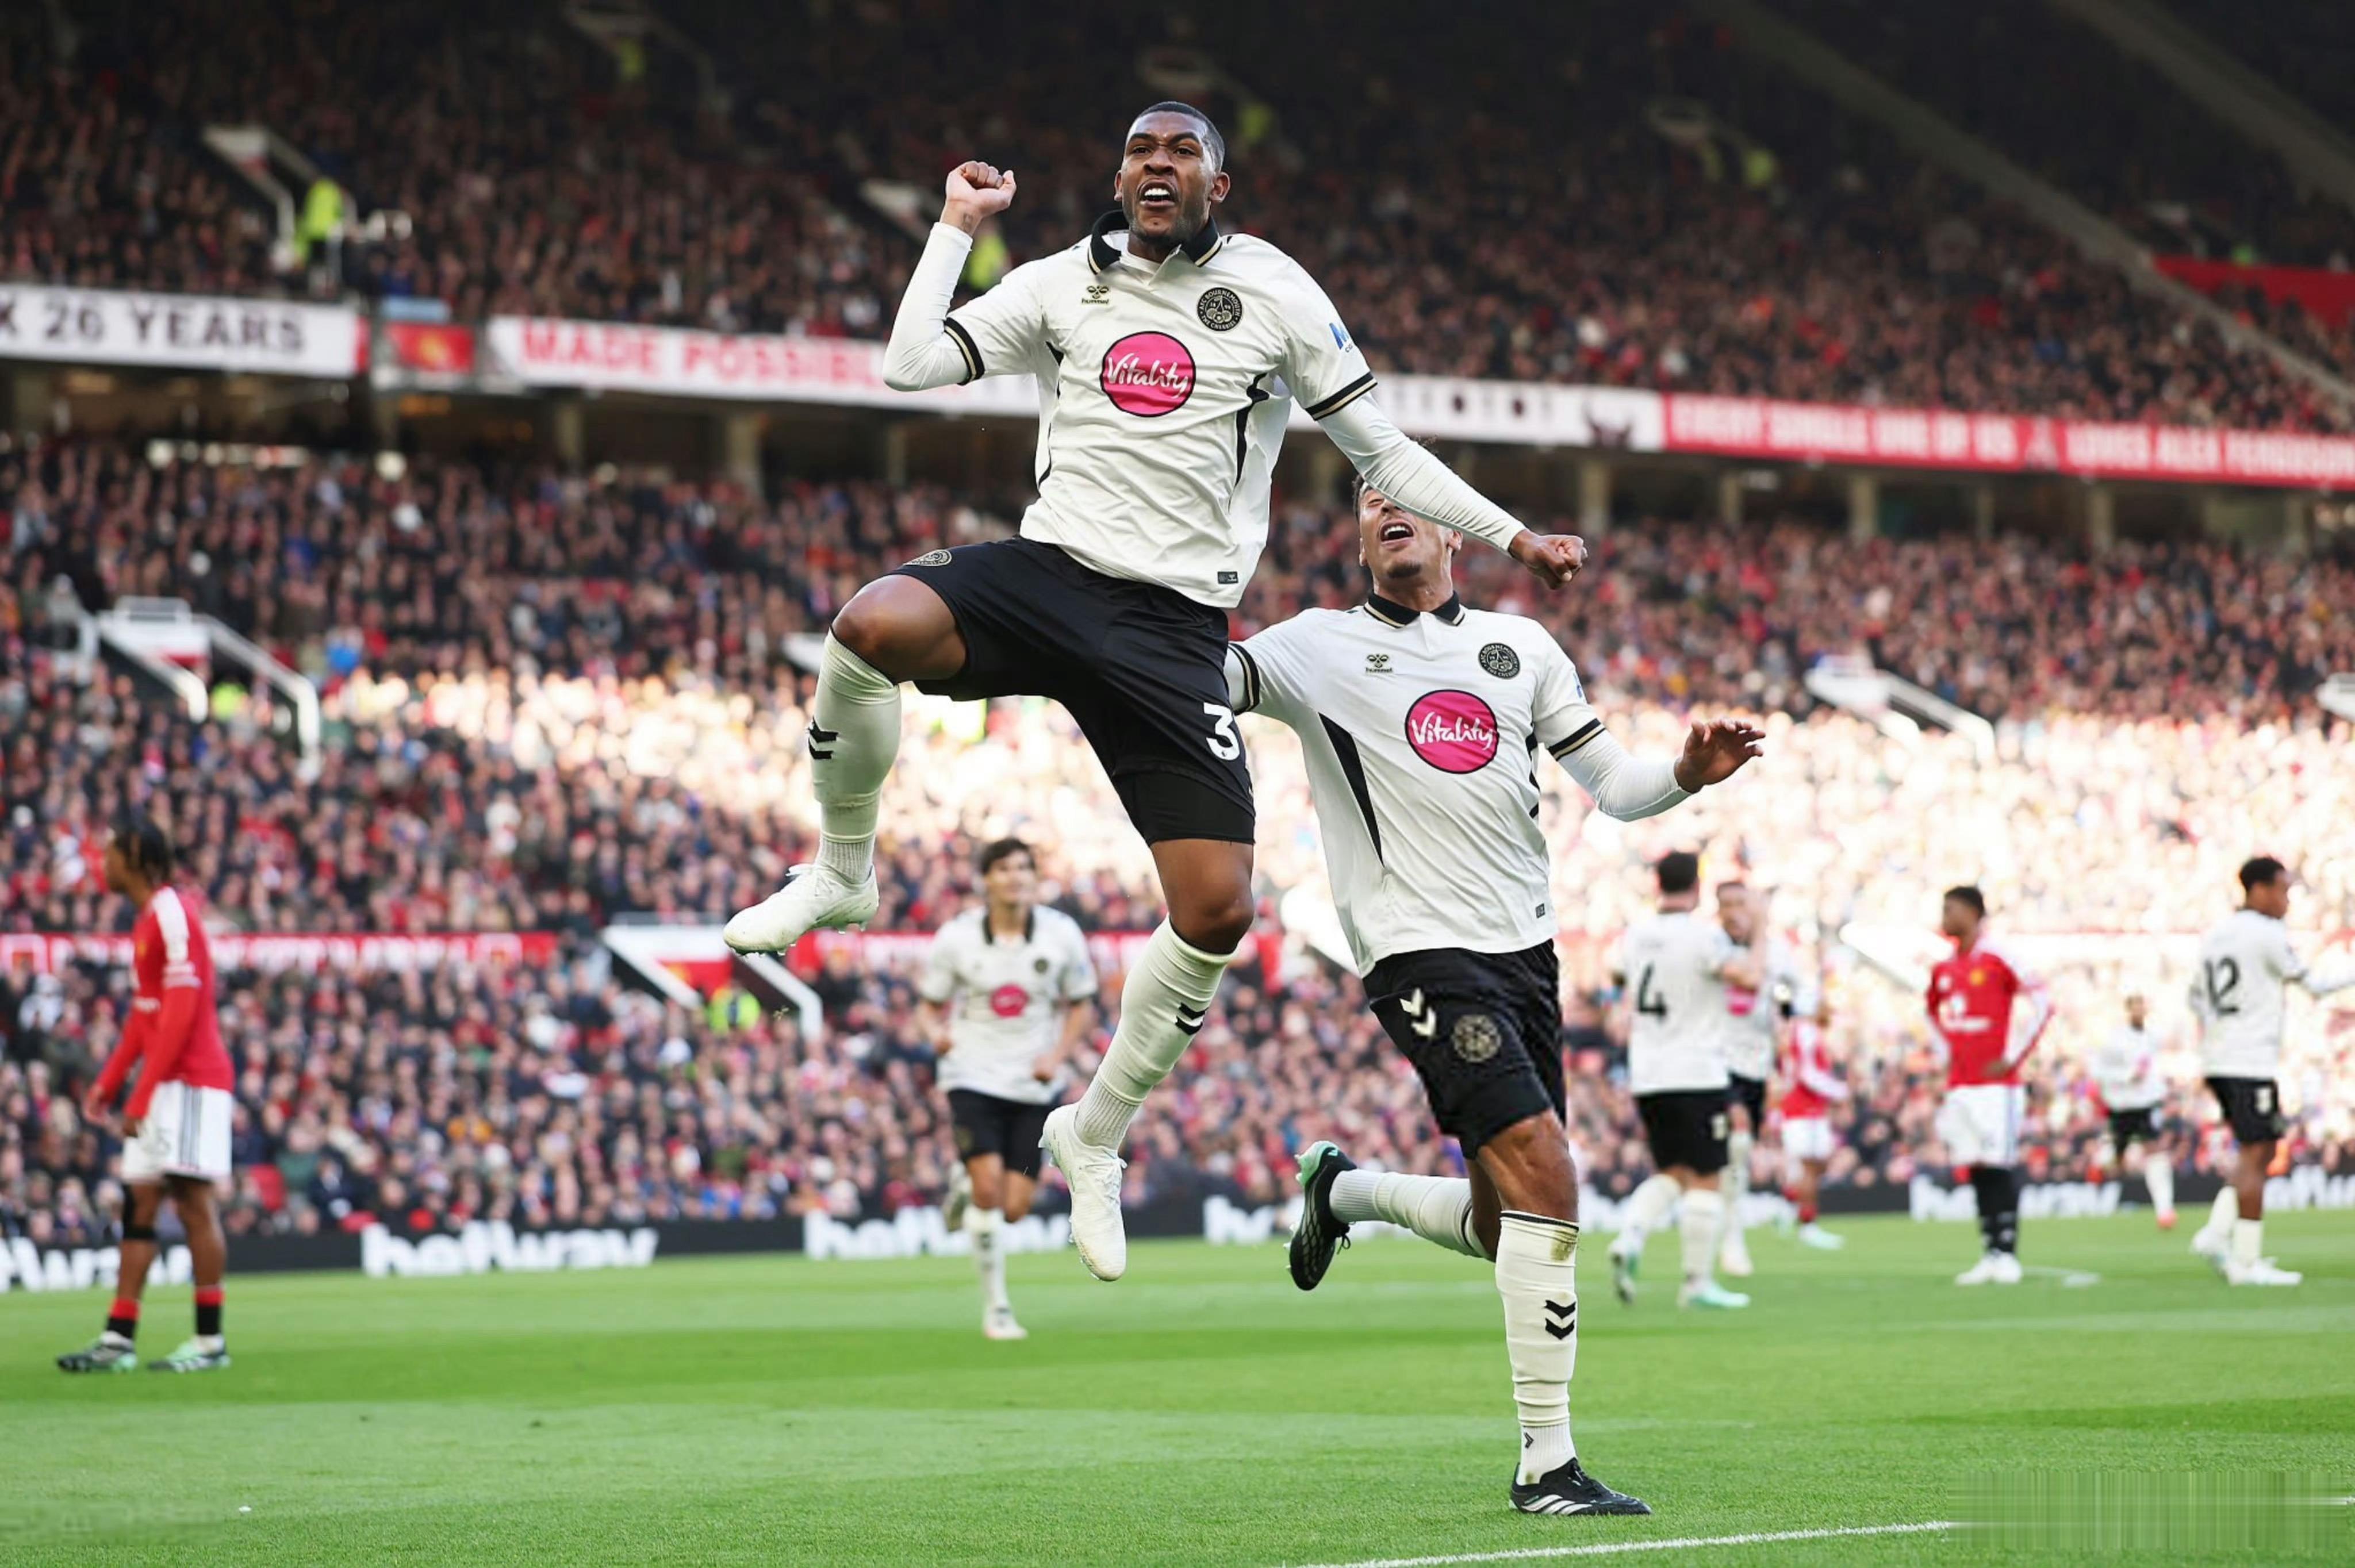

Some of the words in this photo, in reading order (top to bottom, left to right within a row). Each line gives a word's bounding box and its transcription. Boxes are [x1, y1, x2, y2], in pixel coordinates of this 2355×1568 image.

[44, 294, 105, 341] 26
[130, 299, 305, 353] YEARS
[522, 319, 660, 375] MADE
[684, 336, 888, 389] POSSIBL
[1107, 352, 1189, 399] Vitality
[1203, 702, 1240, 761] 3
[1411, 712, 1495, 751] Vitality
[1637, 962, 1668, 1021] 4
[2204, 956, 2241, 1016] 12
